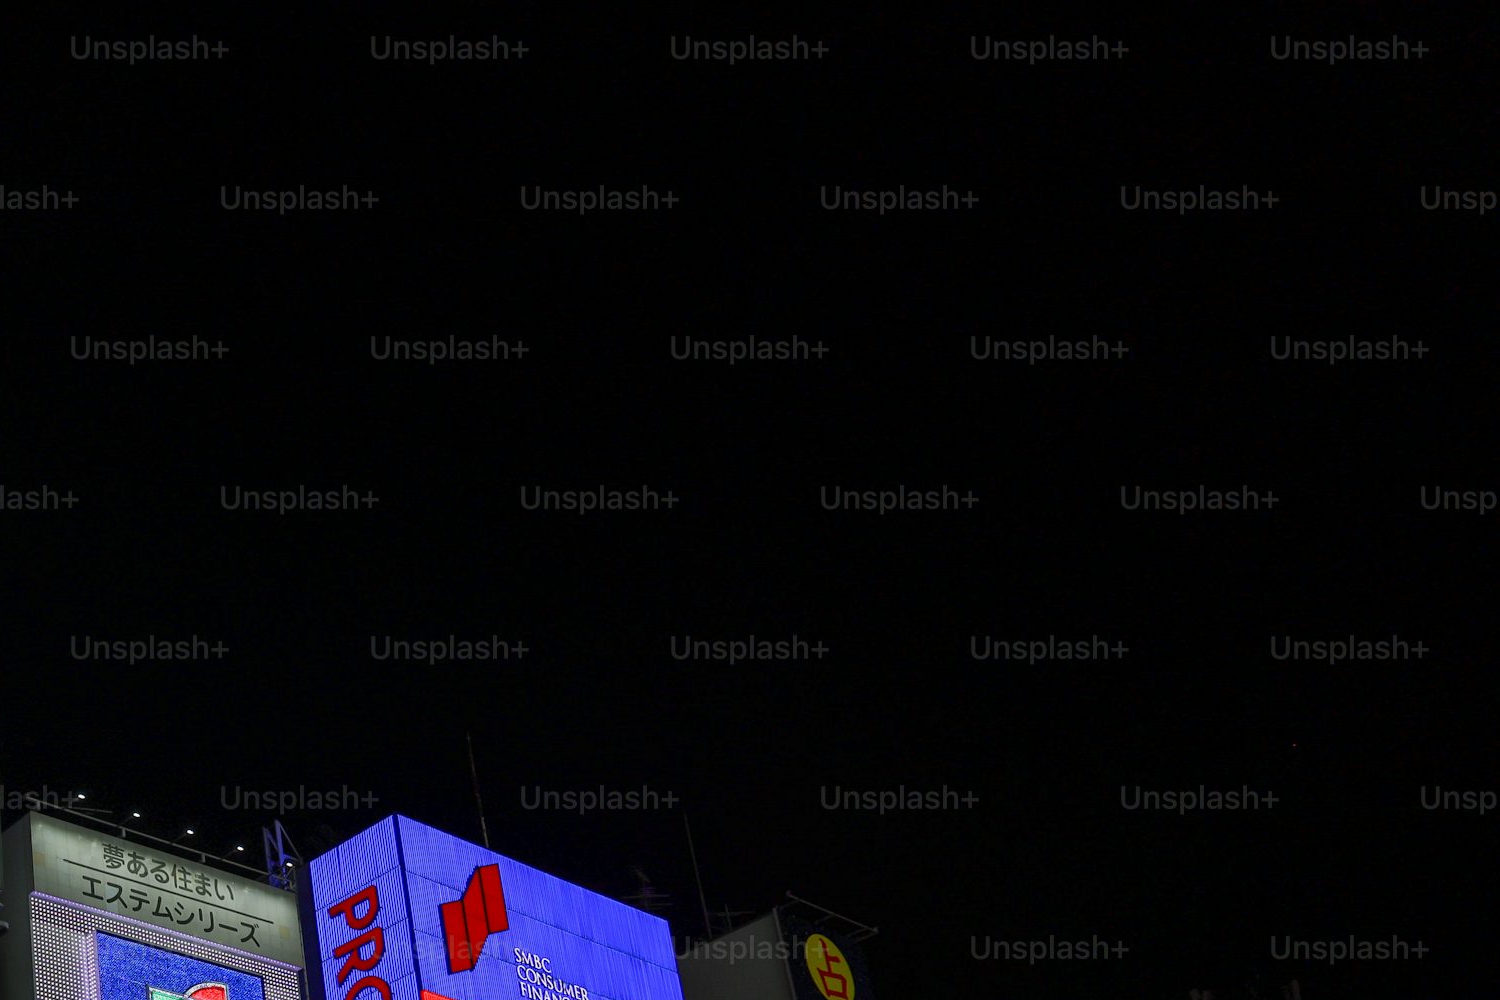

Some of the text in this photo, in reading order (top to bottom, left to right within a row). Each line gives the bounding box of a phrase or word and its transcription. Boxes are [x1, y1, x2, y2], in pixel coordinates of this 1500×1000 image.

[102, 845, 235, 901] 夢ある住まい
[82, 875, 261, 948] エステムシリーズ
[818, 937, 849, 999] 占
